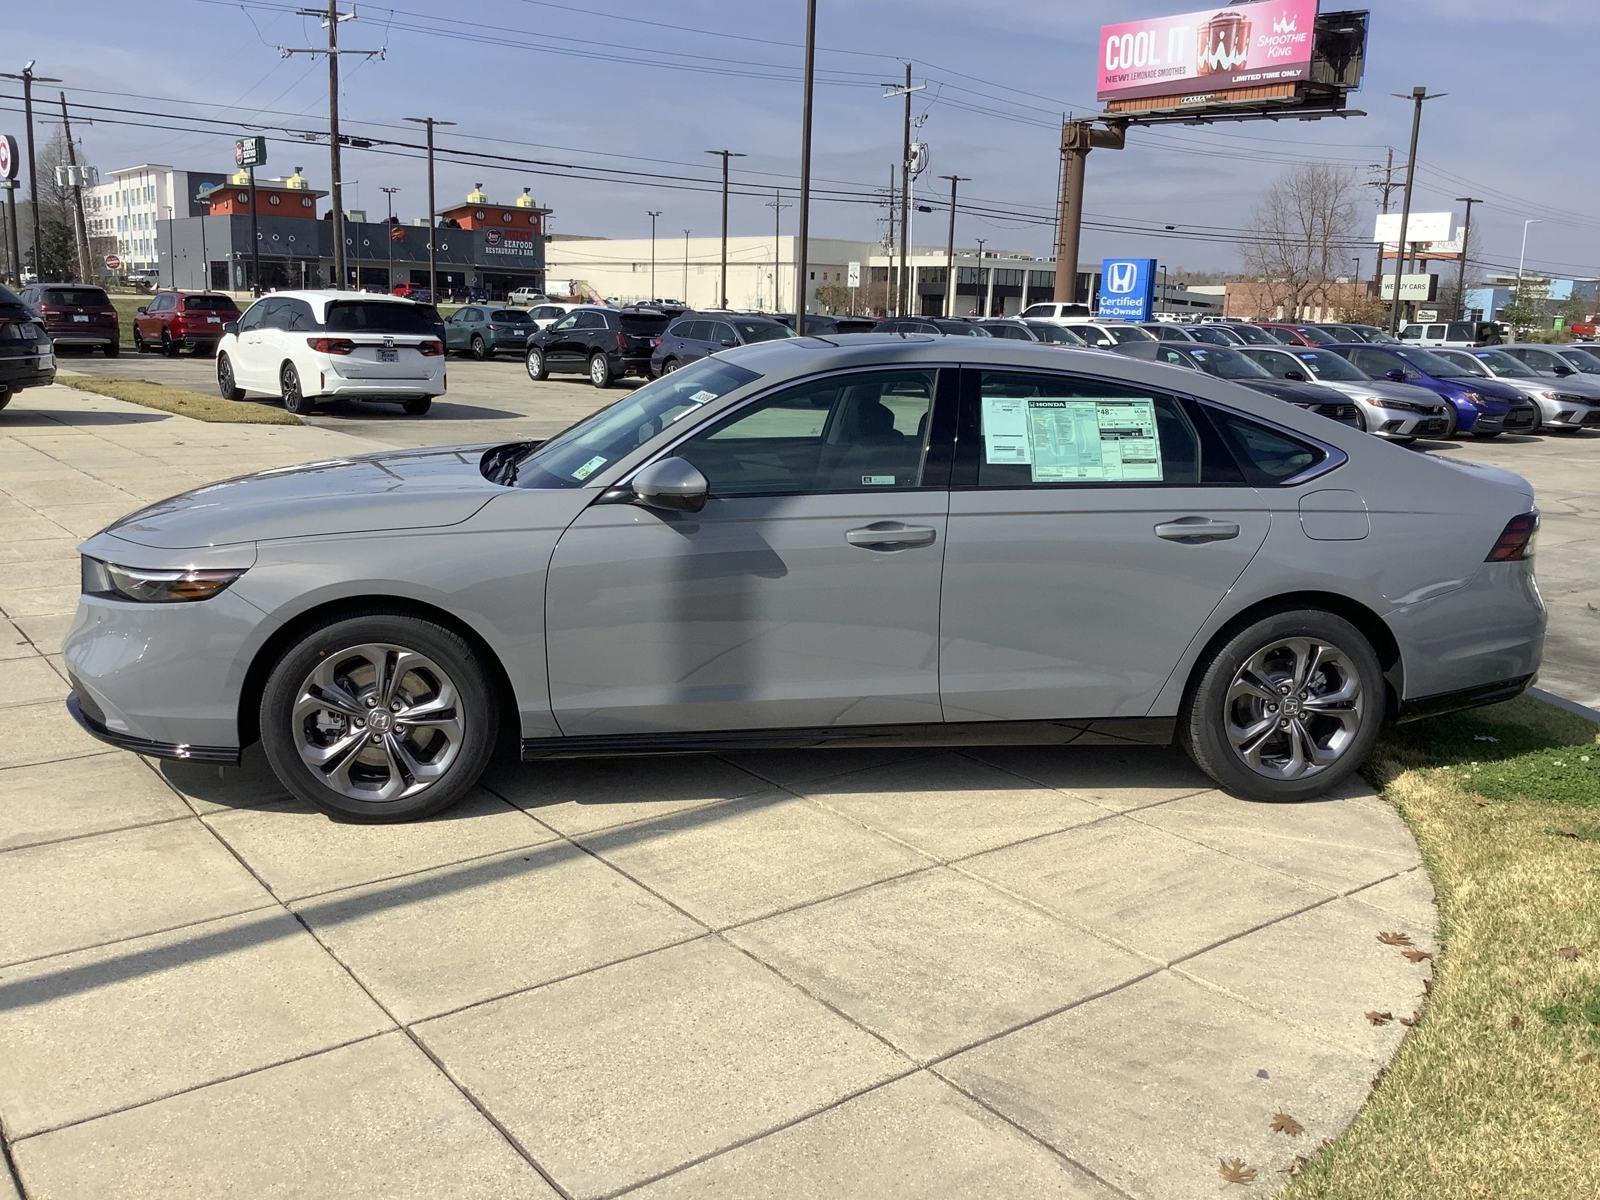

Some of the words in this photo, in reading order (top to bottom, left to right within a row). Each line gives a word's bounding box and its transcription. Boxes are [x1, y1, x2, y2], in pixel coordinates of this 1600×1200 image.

[1257, 33, 1307, 47] SMOOTHIE
[1106, 31, 1160, 71] COOL
[1167, 26, 1190, 64] IT
[1267, 46, 1292, 58] KING
[1105, 74, 1129, 83] NEW!
[1130, 70, 1157, 80] LEMONADE
[1157, 66, 1186, 77] SMOOTHIES
[1232, 73, 1261, 82] LIMITED
[1262, 71, 1280, 79] TIME
[1281, 69, 1302, 77] ONLY
[504, 241, 533, 249] SEAFOOD
[1100, 296, 1143, 306] Certified
[1099, 307, 1142, 316] Pre-Owned
